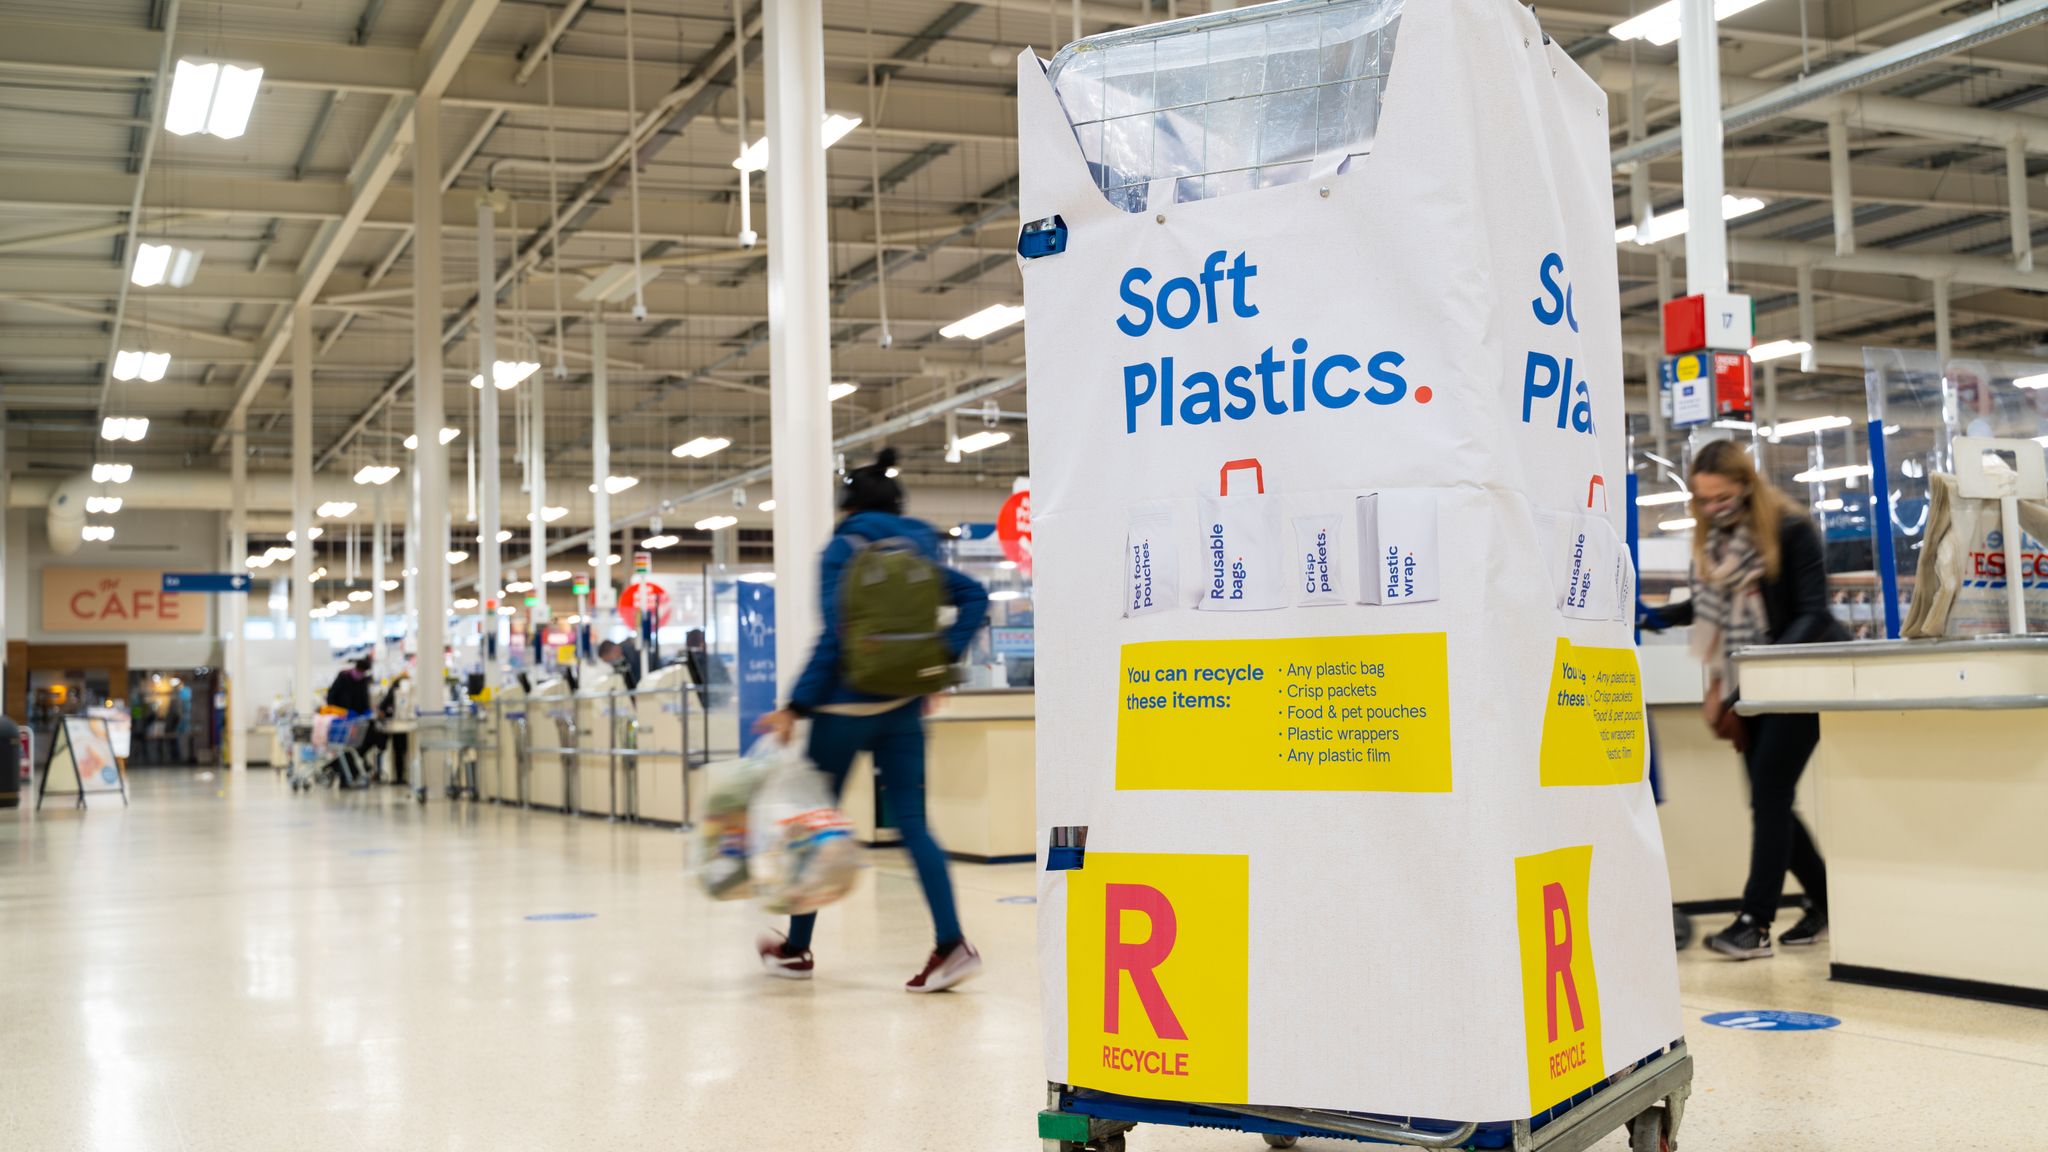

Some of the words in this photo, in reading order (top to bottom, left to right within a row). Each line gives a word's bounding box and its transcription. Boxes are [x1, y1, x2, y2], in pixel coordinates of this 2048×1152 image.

[1116, 250, 1260, 337] Soft
[1124, 338, 1433, 434] Plastics.
[1522, 351, 1597, 437] Pla
[1133, 545, 1142, 579] food
[1142, 538, 1153, 607] pouches.
[1210, 523, 1224, 600] Reusable
[1305, 553, 1316, 594] Crisp
[1317, 528, 1332, 593] packets.
[1387, 545, 1399, 598] Plastic
[1404, 551, 1417, 597] wrap.
[1567, 533, 1586, 607] Reusable
[1968, 551, 2048, 577] ESCO
[1229, 556, 1247, 600] bags.
[1577, 568, 1591, 609] bags.
[1133, 583, 1142, 610] Pet
[1127, 666, 1150, 684] You
[1155, 668, 1187, 682] can
[1194, 664, 1264, 685] recycle
[1287, 663, 1313, 680] Any
[1316, 661, 1357, 679] plastic
[1360, 661, 1385, 678] bag
[1562, 662, 1578, 680] You
[1595, 672, 1609, 687] Any
[1127, 693, 1167, 711] these
[1172, 691, 1231, 708] items:
[1287, 684, 1324, 701] Crisp
[1327, 683, 1377, 700] packets
[1557, 690, 1585, 706] these
[1593, 690, 1611, 704] Crisp
[1611, 692, 1633, 705] packets
[1287, 706, 1323, 719] Food
[1328, 706, 1338, 719] &
[1341, 707, 1363, 722] pet
[1367, 705, 1427, 721] pouches
[1593, 709, 1607, 722] Food
[1613, 710, 1623, 723] pet
[1287, 727, 1333, 741] Plastic
[1337, 729, 1400, 743] wrappers
[1287, 749, 1313, 765] Any
[1318, 748, 1363, 765] plastic
[1367, 748, 1391, 762] film
[1103, 882, 1189, 1041] R
[1542, 881, 1585, 1044] R
[1102, 1045, 1189, 1077] RECYCLE
[1550, 1041, 1587, 1080] RECYCLE
